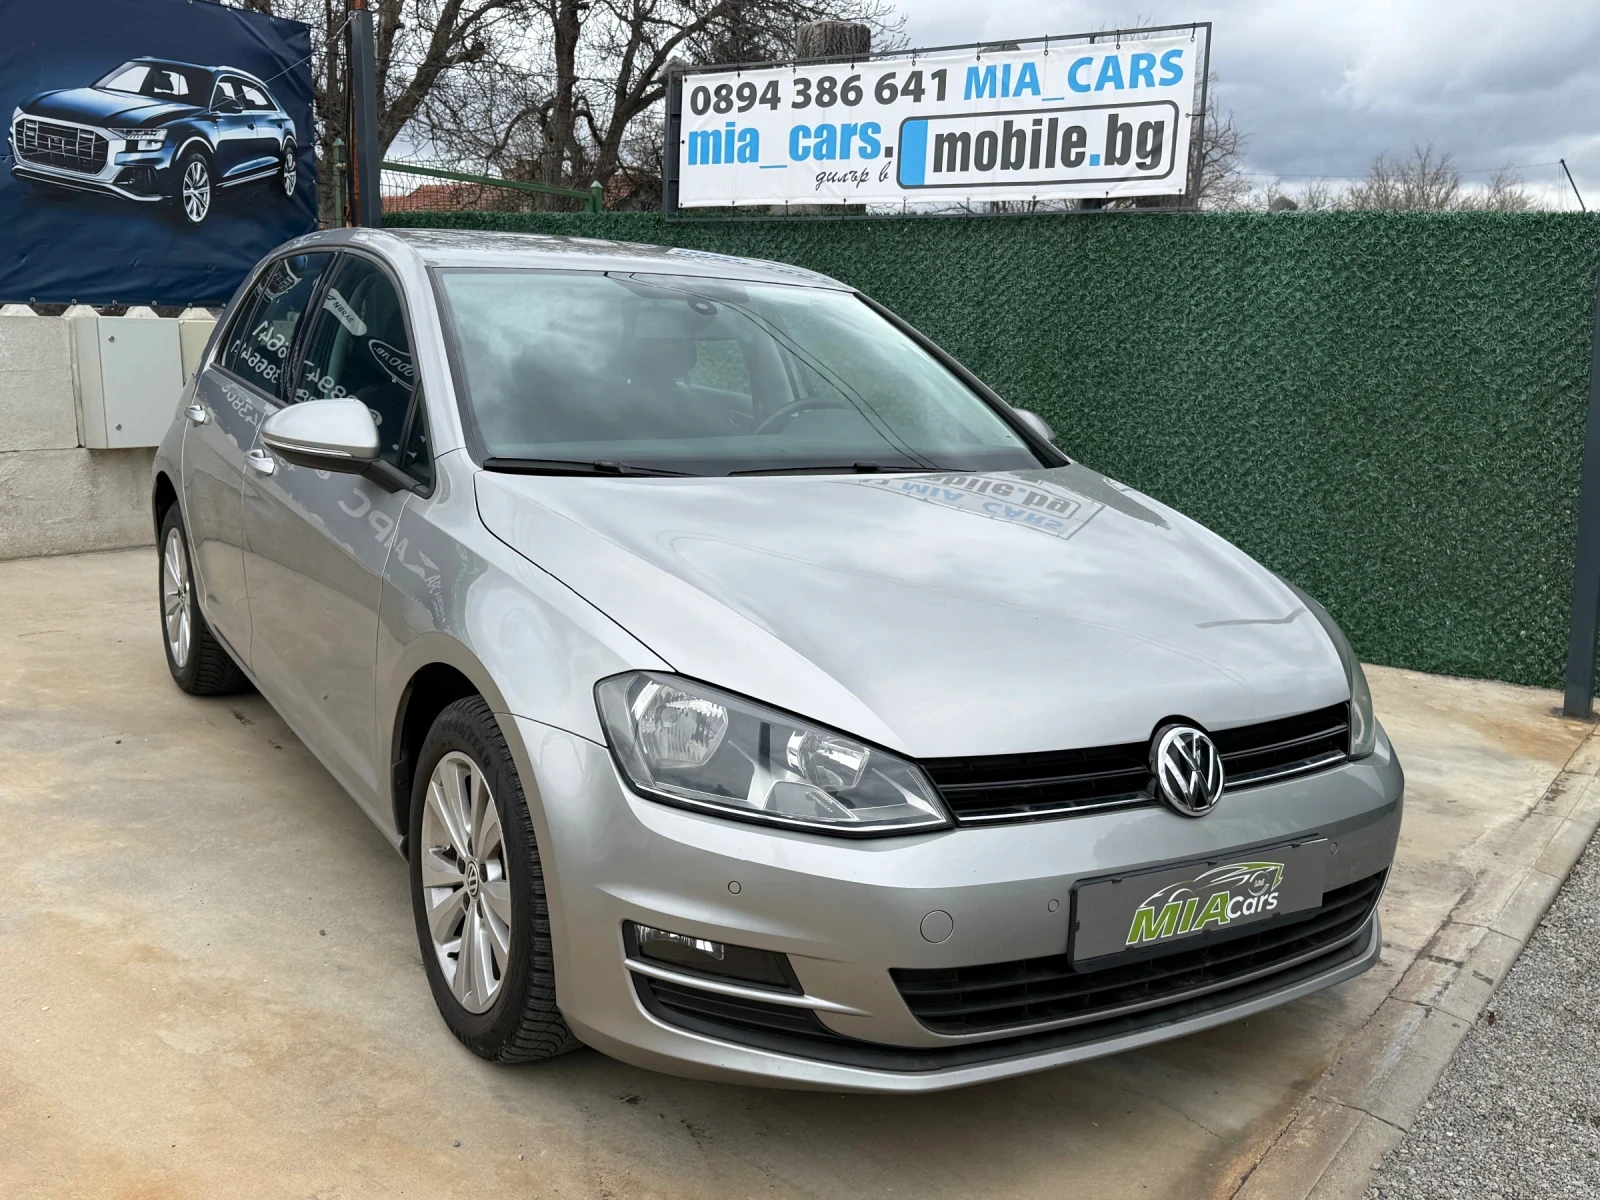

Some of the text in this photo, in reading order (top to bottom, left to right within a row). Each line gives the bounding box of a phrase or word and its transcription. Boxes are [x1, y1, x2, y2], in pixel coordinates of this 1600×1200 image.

[690, 80, 781, 116] 0894
[791, 74, 863, 109] 386
[874, 68, 947, 105] 641
[932, 113, 1165, 172] mobile.bg
[815, 166, 870, 191] дилър
